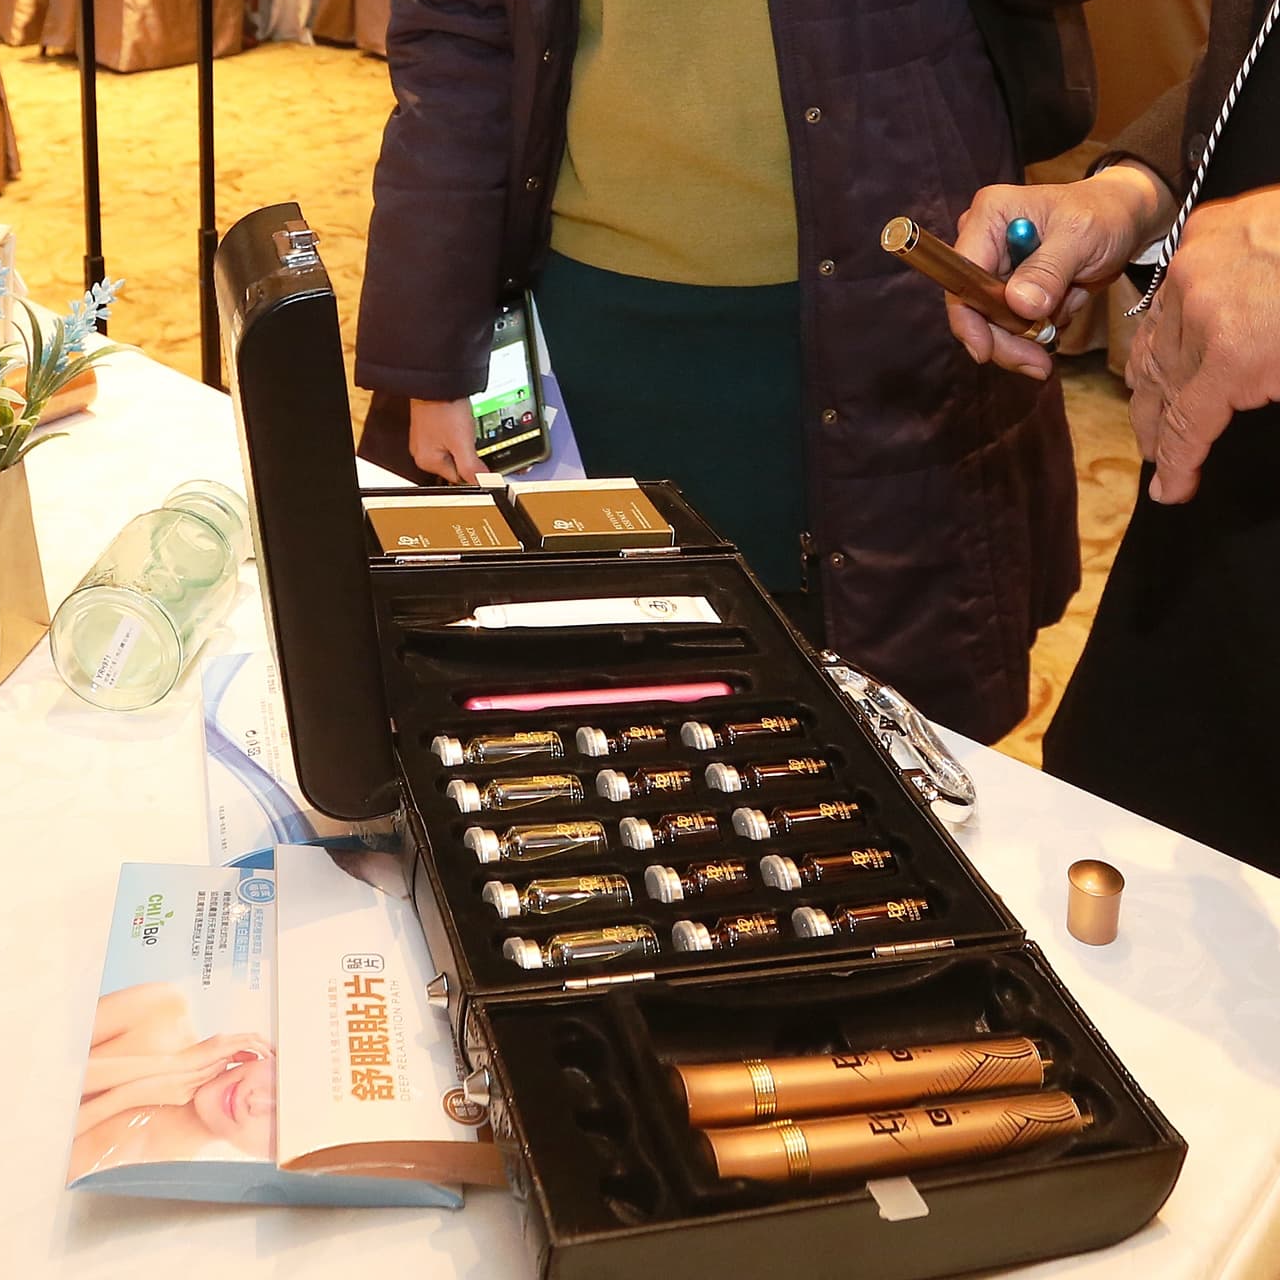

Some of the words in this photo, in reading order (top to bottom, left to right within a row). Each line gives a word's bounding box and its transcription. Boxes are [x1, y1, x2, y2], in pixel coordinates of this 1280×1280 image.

[389, 979, 401, 1005] PATH
[344, 974, 395, 1102] 舒眠貼片
[392, 1008, 408, 1070] RELAXATION
[399, 1074, 411, 1102] DEEP
